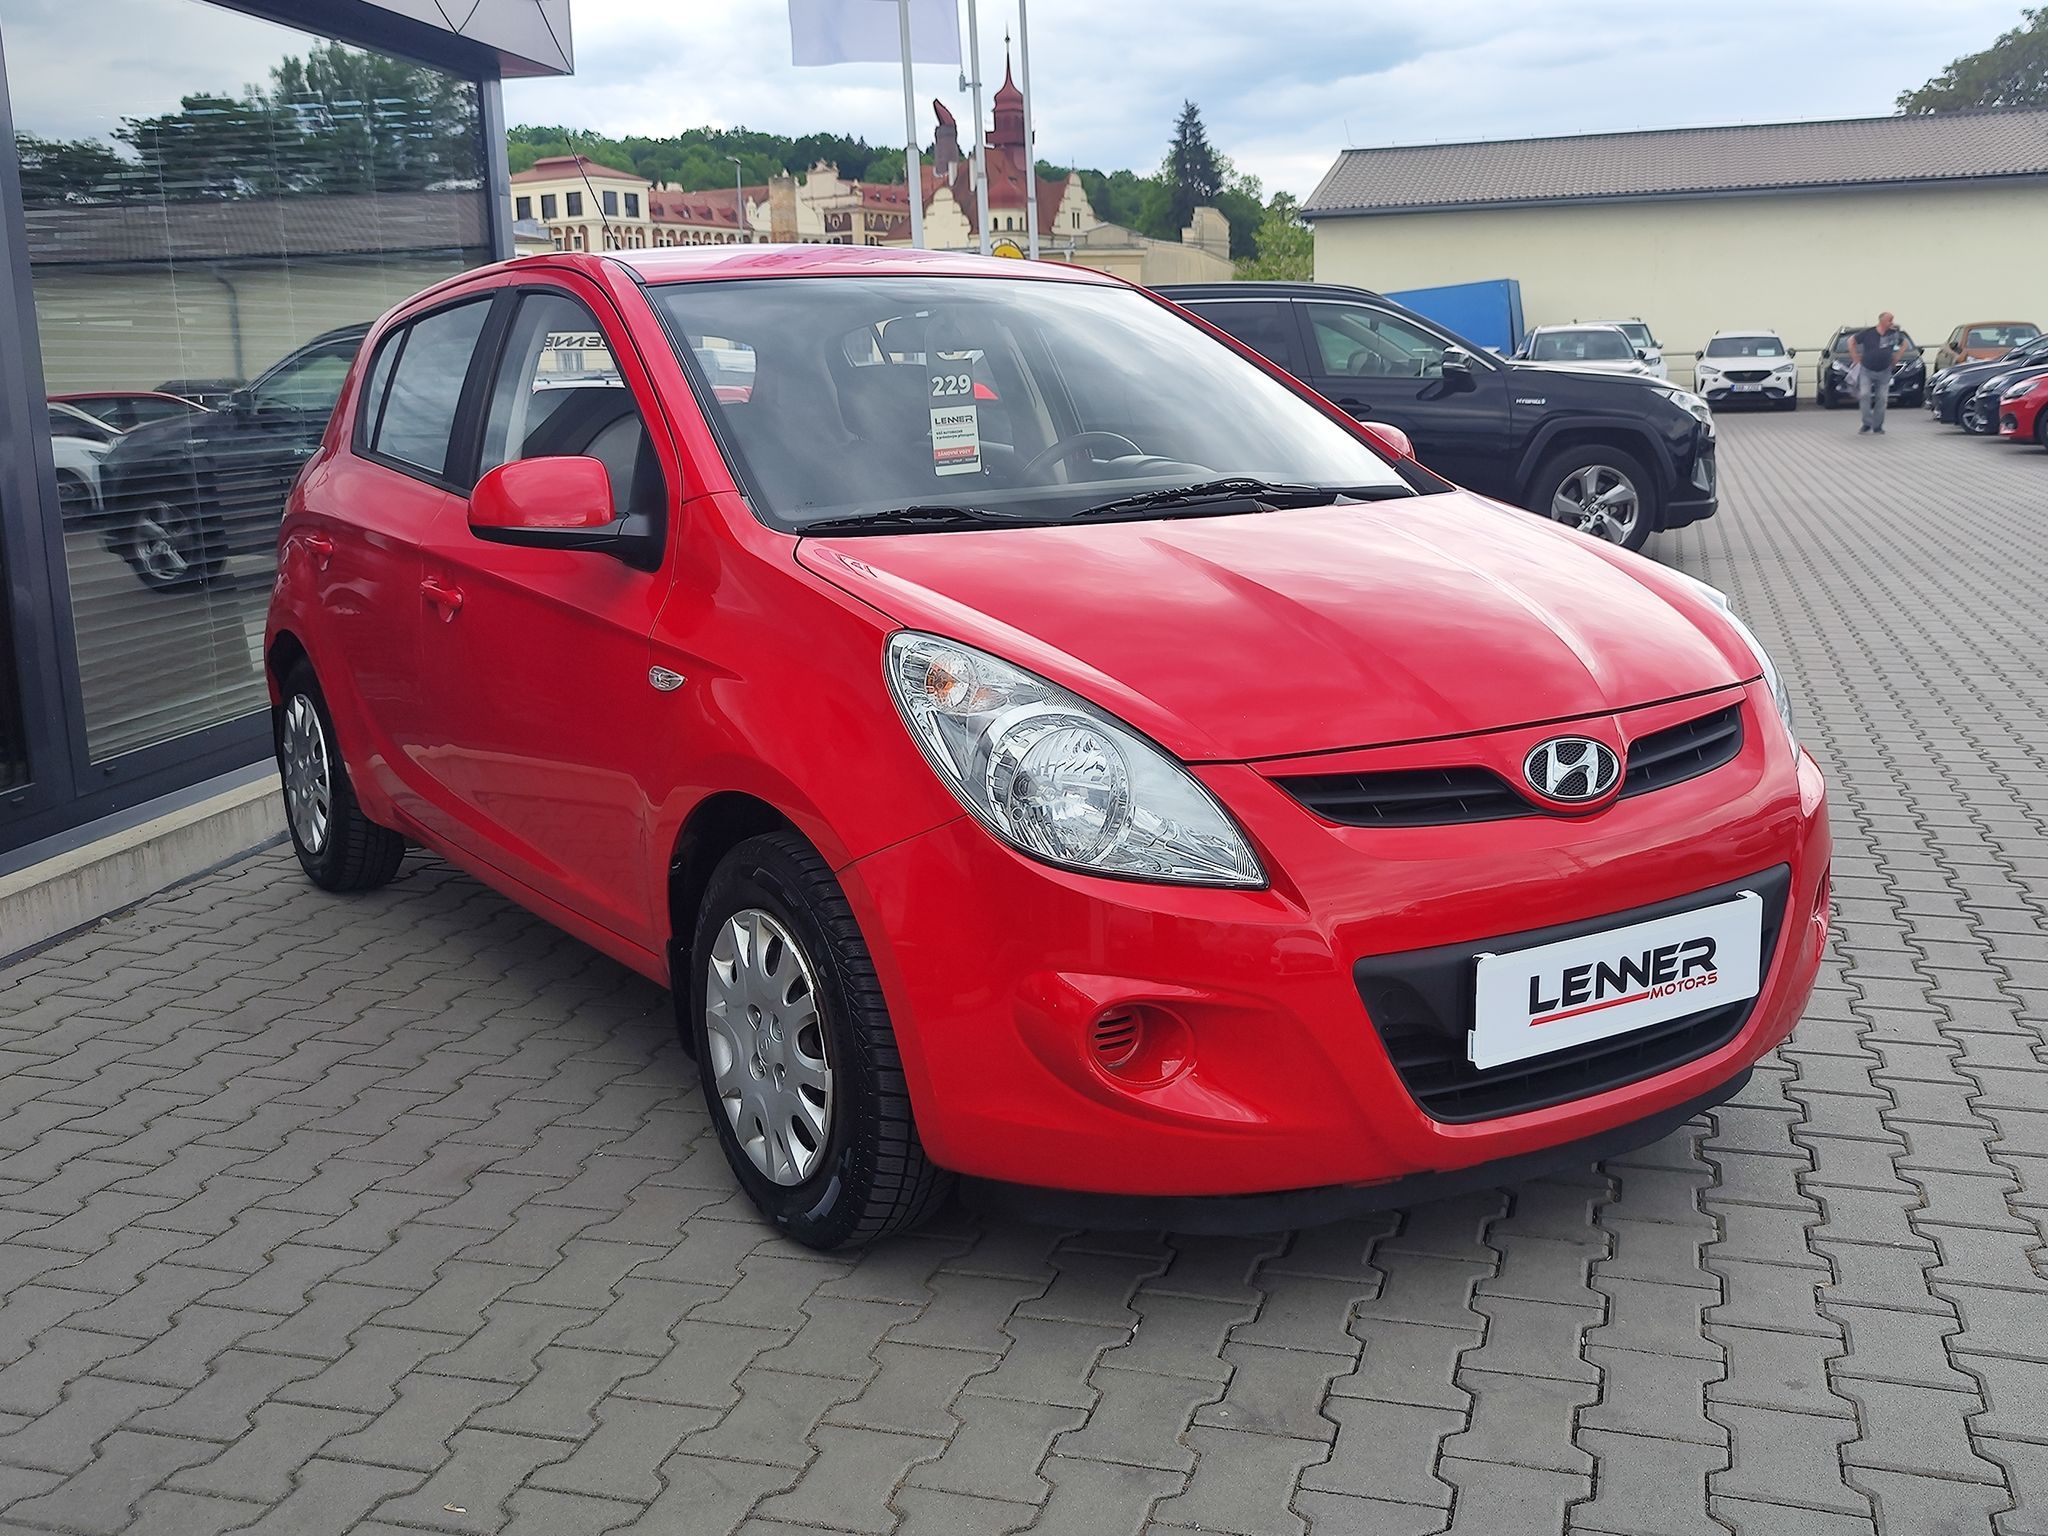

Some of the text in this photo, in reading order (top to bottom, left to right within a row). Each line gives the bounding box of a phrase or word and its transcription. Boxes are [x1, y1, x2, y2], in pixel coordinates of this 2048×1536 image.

[931, 374, 972, 397] 229
[934, 415, 974, 425] LENNER
[1528, 936, 1719, 1016] LENNER
[1650, 971, 1719, 1000] MOTORS
